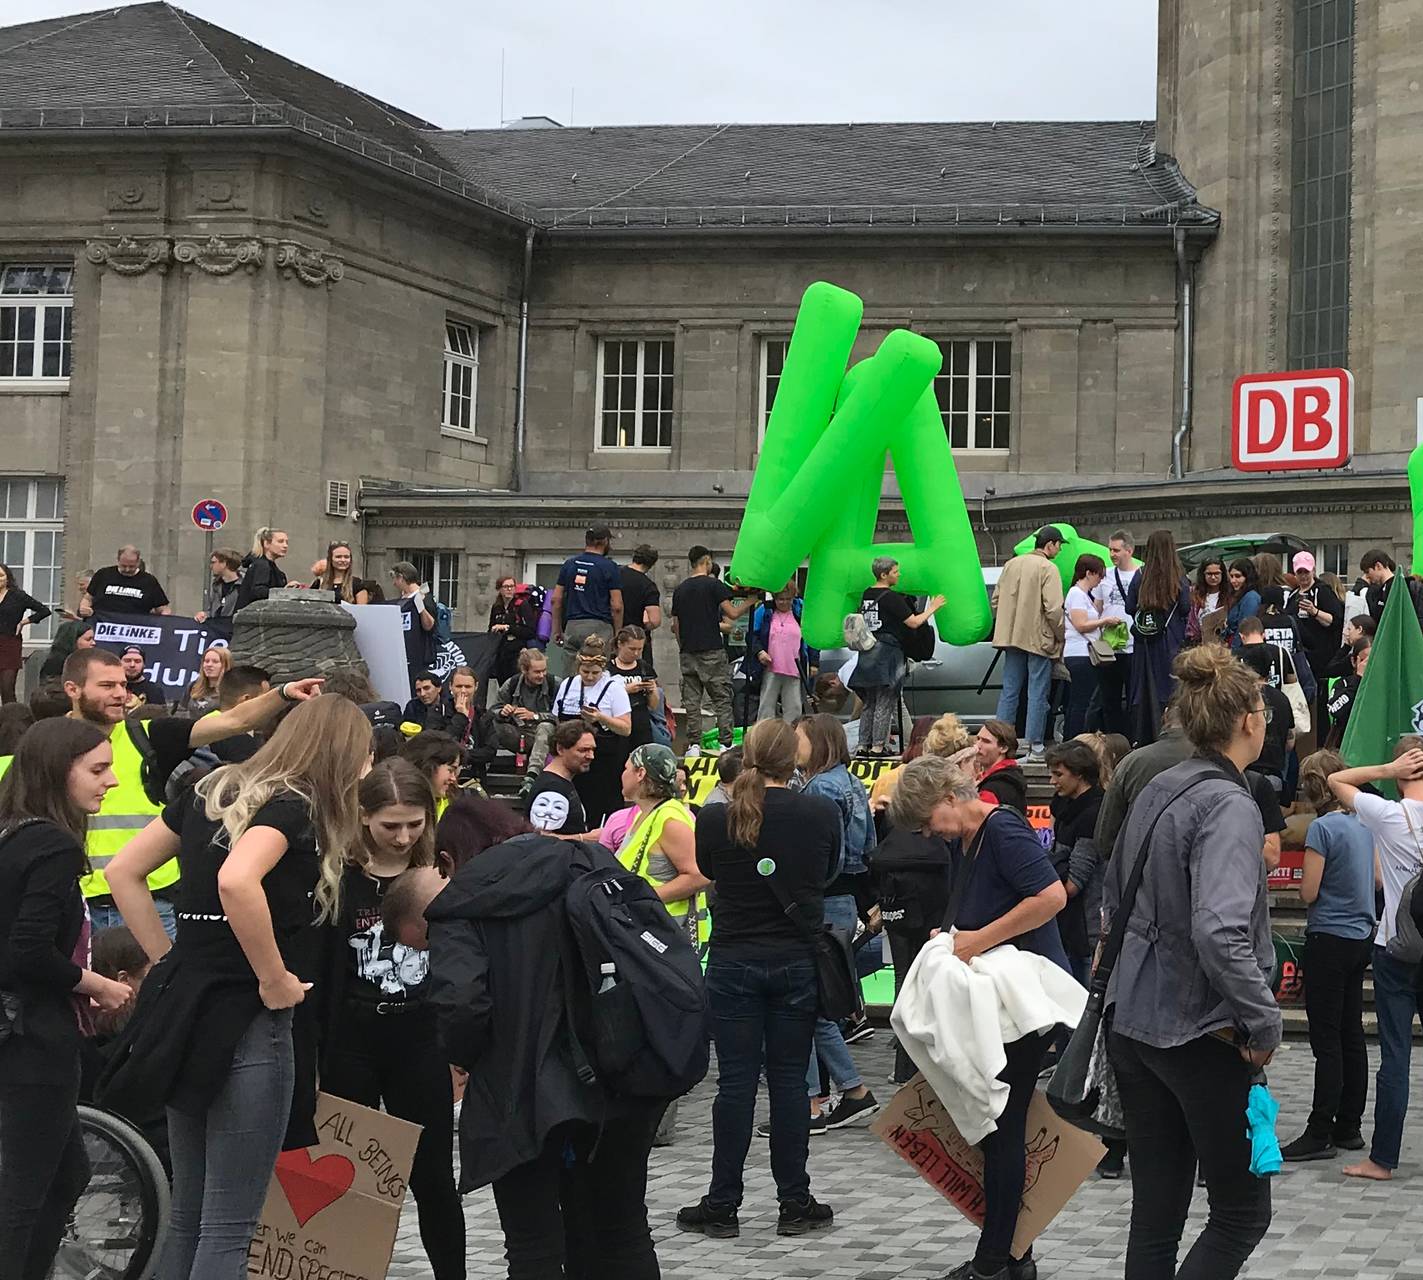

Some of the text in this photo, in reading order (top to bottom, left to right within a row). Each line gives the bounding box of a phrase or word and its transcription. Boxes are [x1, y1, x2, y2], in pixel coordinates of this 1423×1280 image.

[1247, 386, 1333, 454] DB
[97, 624, 115, 636] DIE
[319, 1112, 407, 1198] ALL BEINGS
[247, 1238, 294, 1280] END
[304, 1239, 327, 1255] can
